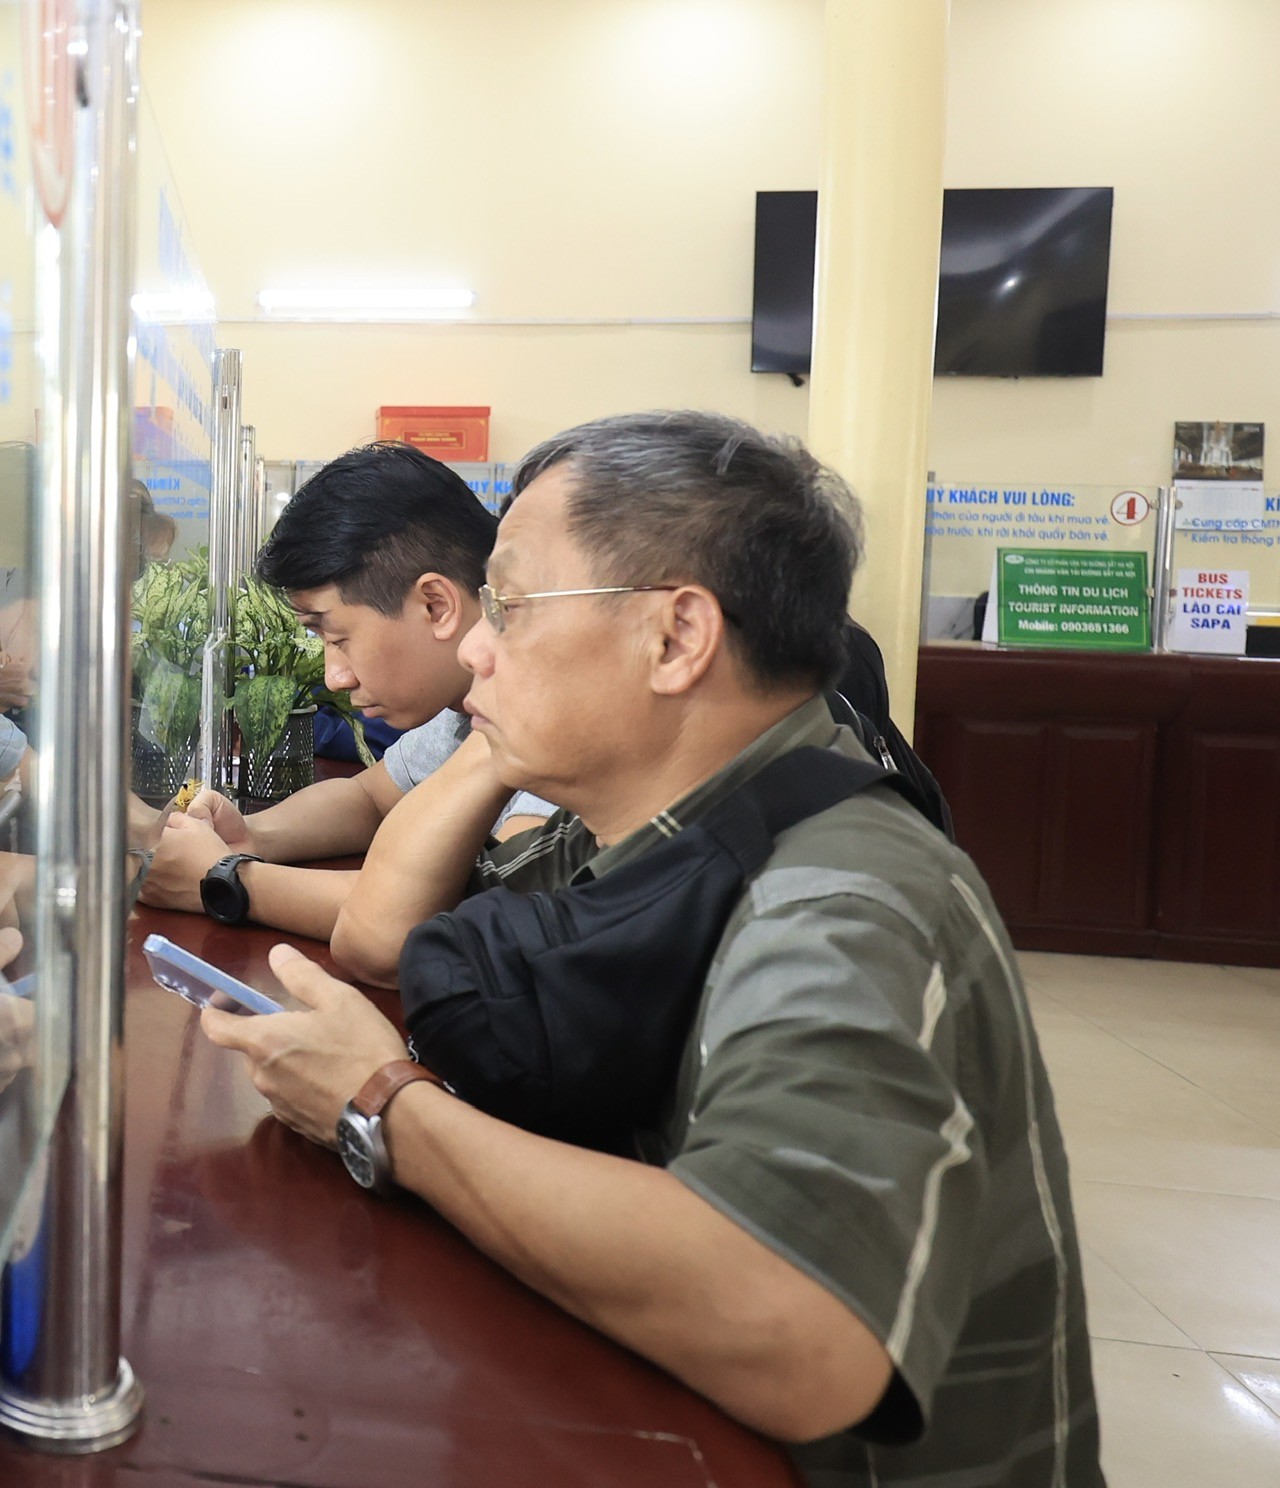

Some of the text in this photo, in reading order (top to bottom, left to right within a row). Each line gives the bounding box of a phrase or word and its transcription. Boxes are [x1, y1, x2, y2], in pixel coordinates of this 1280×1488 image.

[950, 488, 998, 504] KHÁCH
[1003, 491, 1027, 505] VUI
[1033, 489, 1075, 507] LÒNG:
[1116, 496, 1138, 520] 4
[1049, 514, 1064, 523] khi
[1068, 516, 1092, 524] mua
[1192, 518, 1222, 530] Cung
[978, 527, 993, 536] khi
[1198, 573, 1228, 584] BUS
[1018, 583, 1128, 600] THÔNG TIN DU LỊCH
[1183, 587, 1242, 599] TICKETS
[1008, 602, 1138, 616] TOURIST INFORMATION
[1217, 604, 1241, 615] CAI
[1018, 620, 1058, 632] Mobile:
[1191, 618, 1231, 629] SAPA
